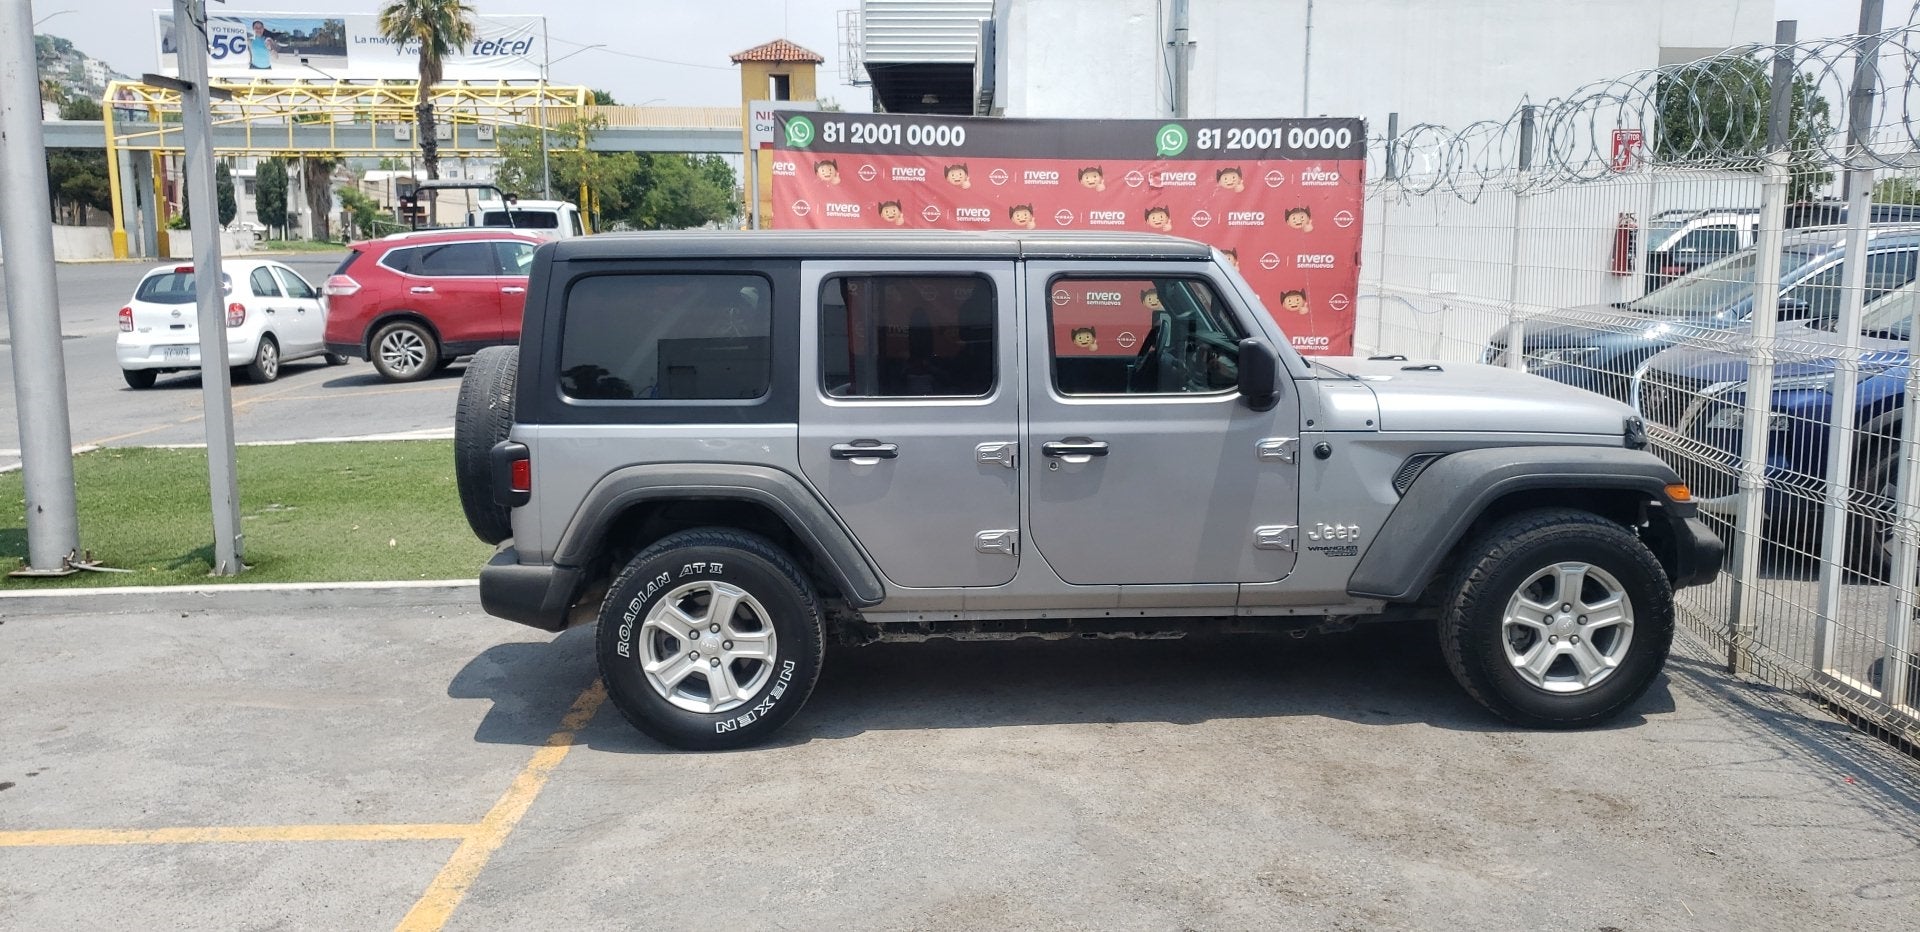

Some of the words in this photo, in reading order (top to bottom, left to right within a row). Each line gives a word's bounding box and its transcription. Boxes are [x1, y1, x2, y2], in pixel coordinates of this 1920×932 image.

[211, 35, 246, 59] 5G
[473, 37, 534, 55] telcel
[823, 122, 845, 142] 81
[851, 123, 900, 144] 2001
[907, 124, 966, 147] 0000
[1196, 128, 1221, 149] 81
[1227, 128, 1281, 149] 2001
[1288, 127, 1350, 149] 0000
[892, 168, 926, 176] rivero
[1024, 171, 1059, 180] rivero
[1161, 172, 1197, 181] rivero
[1302, 172, 1339, 181] rivero
[826, 203, 860, 212] rivero
[956, 208, 990, 217] rivero
[1090, 211, 1125, 220] rivero
[1228, 211, 1264, 220] rivero
[1297, 254, 1334, 263] rivero
[1086, 292, 1121, 300] rivero
[1292, 336, 1329, 345] rivero
[1308, 522, 1360, 542] Jeep
[617, 571, 671, 658] ROADIAN
[679, 562, 706, 577] AT
[716, 660, 795, 733] NEXEN
